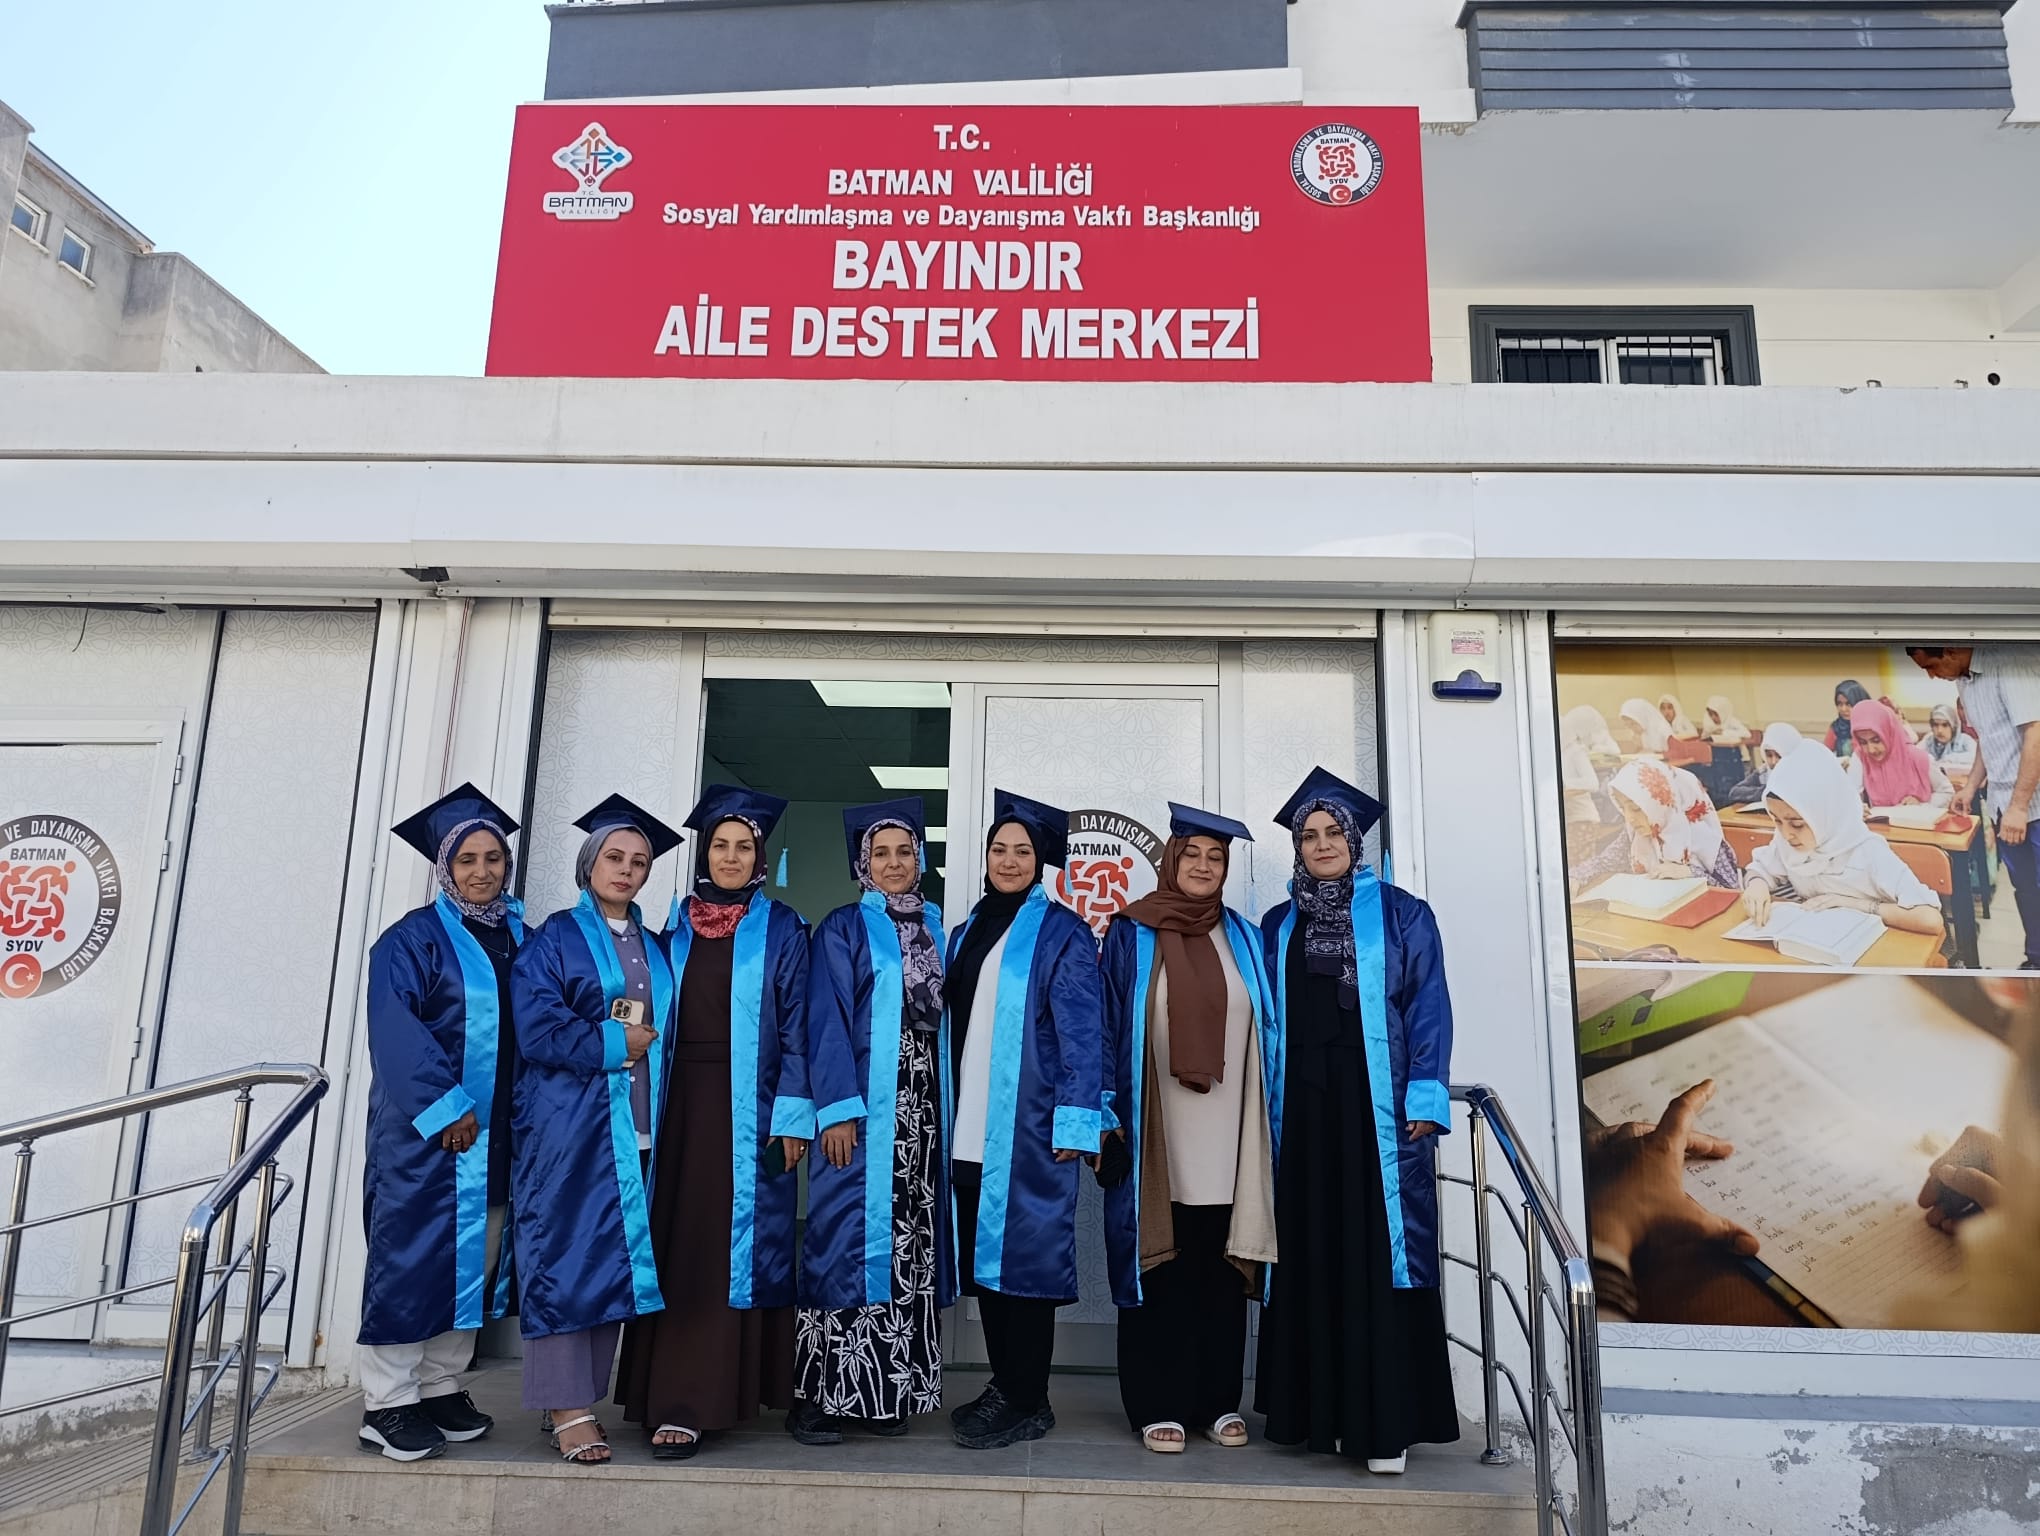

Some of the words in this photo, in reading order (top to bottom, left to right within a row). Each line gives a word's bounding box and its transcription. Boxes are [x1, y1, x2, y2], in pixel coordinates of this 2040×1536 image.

[933, 124, 991, 150] T.C.
[1313, 127, 1324, 137] VE
[828, 169, 953, 195] BATMAN
[973, 162, 1093, 196] VALİLİĞİ
[549, 197, 628, 207] BATMAN
[662, 202, 739, 229] Sosyal
[748, 203, 893, 229] Yardımlaşma
[902, 209, 930, 226] ve
[938, 204, 1065, 231] Dayanışma
[1073, 205, 1132, 227] Vakfı
[1143, 206, 1260, 232] Başkanlığı
[832, 239, 1084, 291] BAYINDIR
[654, 293, 771, 356] AİLE
[790, 305, 999, 359] DESTEK
[1021, 297, 1260, 360] MERKEZİ
[4, 823, 22, 842] VE
[31, 820, 101, 859] DAYANIŞMA
[1080, 815, 1156, 855] DAYANIŞMA
[10, 848, 67, 861] BATMAN
[95, 858, 118, 899] VAKFI
[6, 940, 44, 952] SYDV
[60, 908, 115, 982] BAŞKANLIĞI
